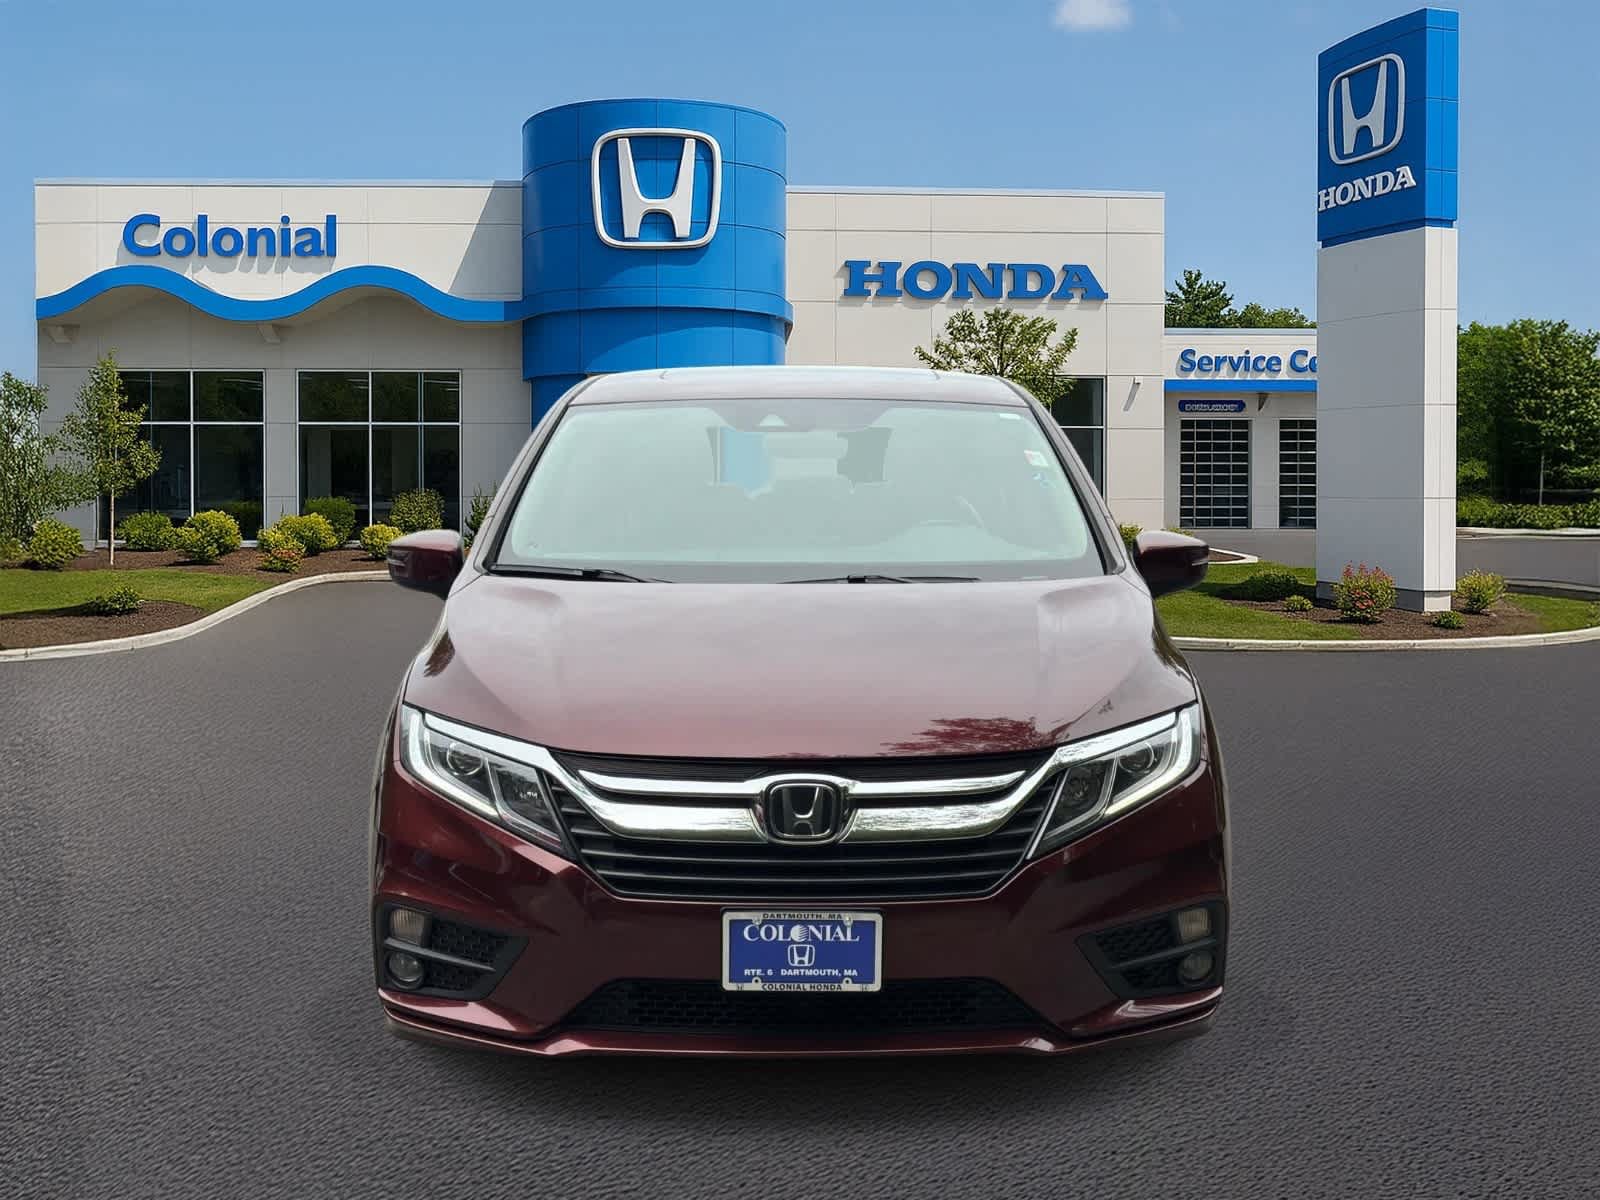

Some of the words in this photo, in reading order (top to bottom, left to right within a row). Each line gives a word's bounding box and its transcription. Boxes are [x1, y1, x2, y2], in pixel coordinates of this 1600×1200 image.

[1318, 165, 1417, 212] HONDA
[123, 213, 337, 257] Colonial
[843, 260, 1109, 301] HONDA
[1180, 348, 1282, 373] Service
[743, 924, 860, 942] COLONIAL
[843, 969, 858, 977] MA
[761, 983, 808, 991] COLONIAL
